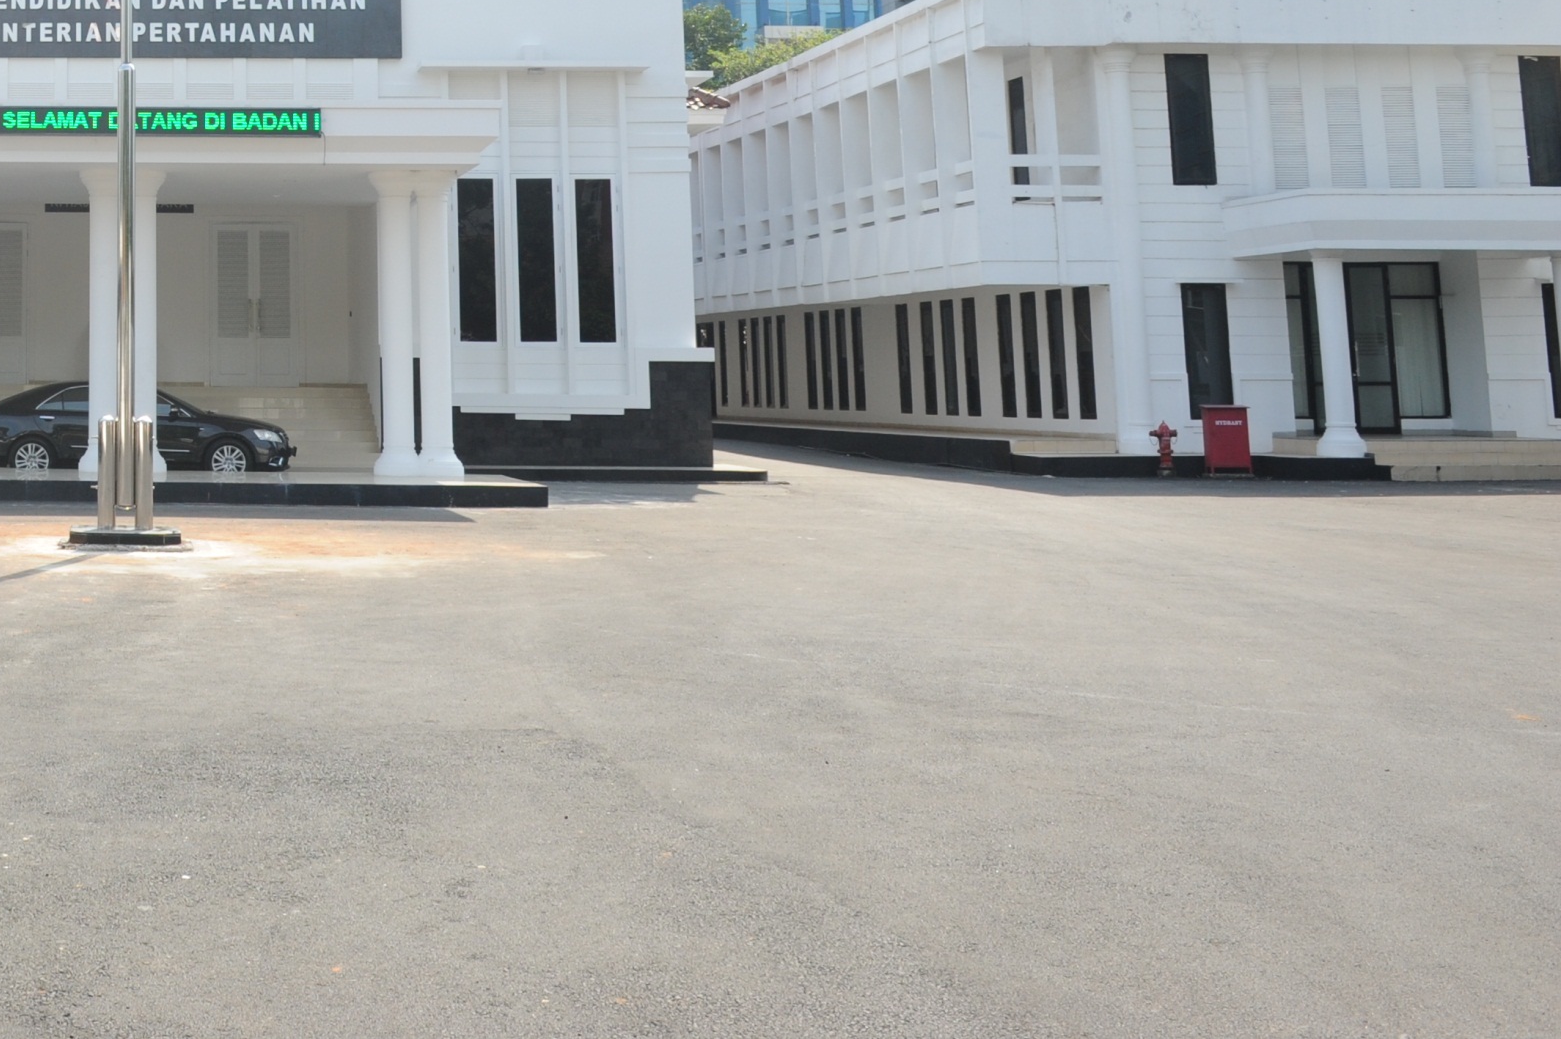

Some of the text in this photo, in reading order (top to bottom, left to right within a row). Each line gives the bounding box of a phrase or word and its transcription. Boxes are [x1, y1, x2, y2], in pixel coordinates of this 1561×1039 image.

[132, 22, 315, 43] PERTAHANAN
[2, 111, 102, 129] SELAMAT
[108, 111, 198, 130] DTANG
[204, 112, 225, 130] DI
[232, 112, 308, 131] BADAN
